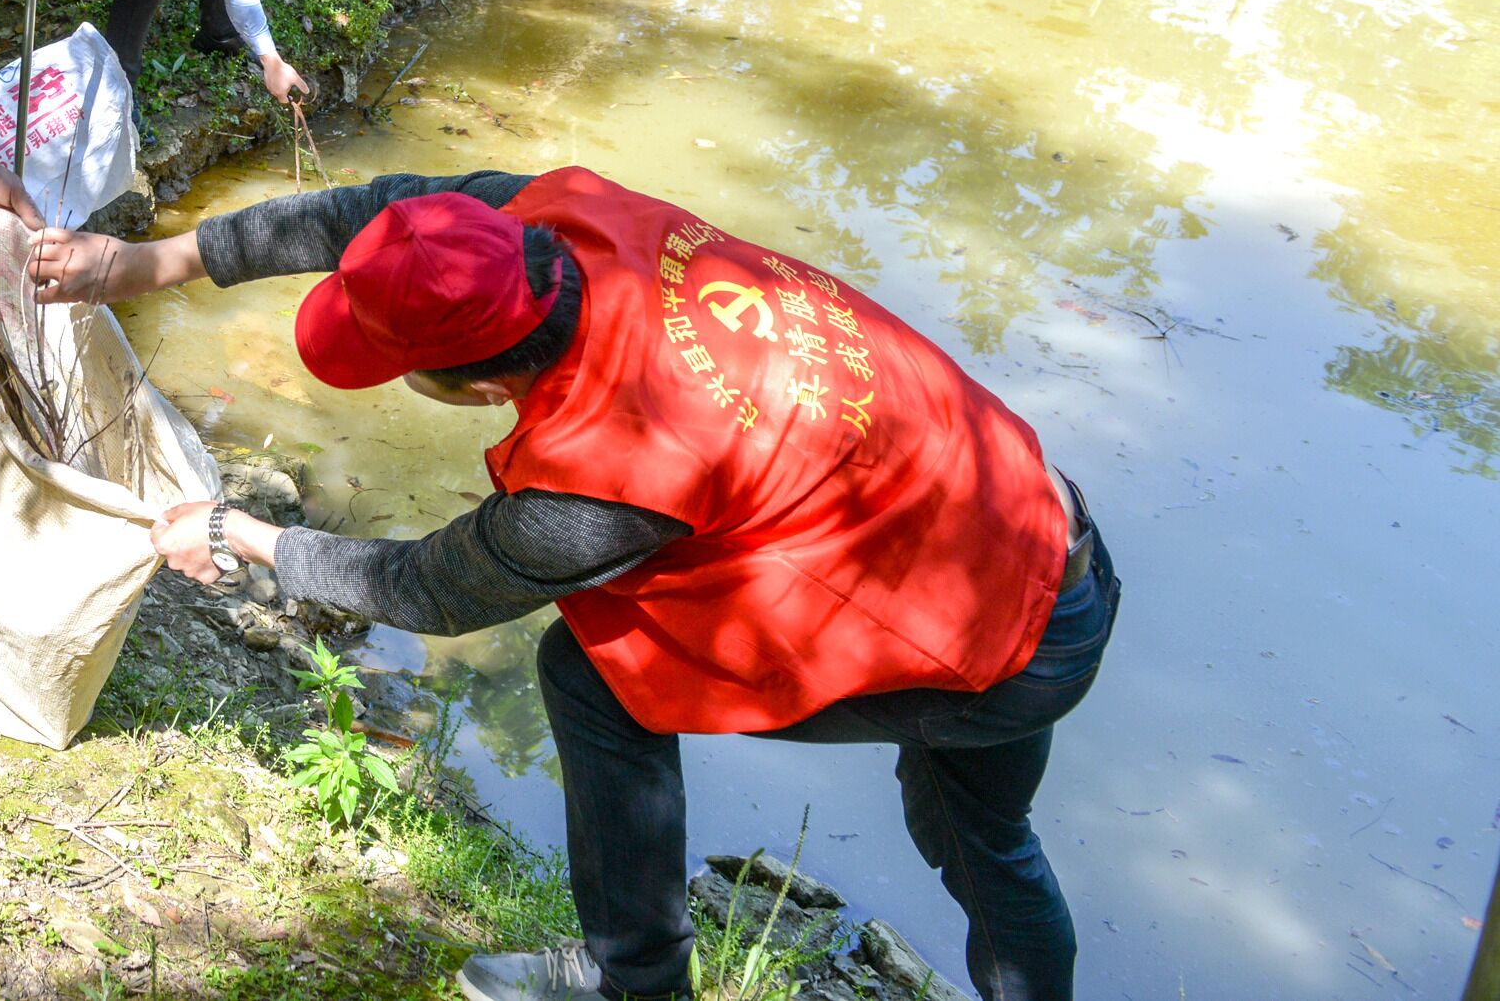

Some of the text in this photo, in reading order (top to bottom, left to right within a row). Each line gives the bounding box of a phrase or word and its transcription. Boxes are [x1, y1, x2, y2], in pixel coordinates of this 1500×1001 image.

[762, 255, 830, 421] 真情服务
[807, 270, 875, 439] 从我做起
